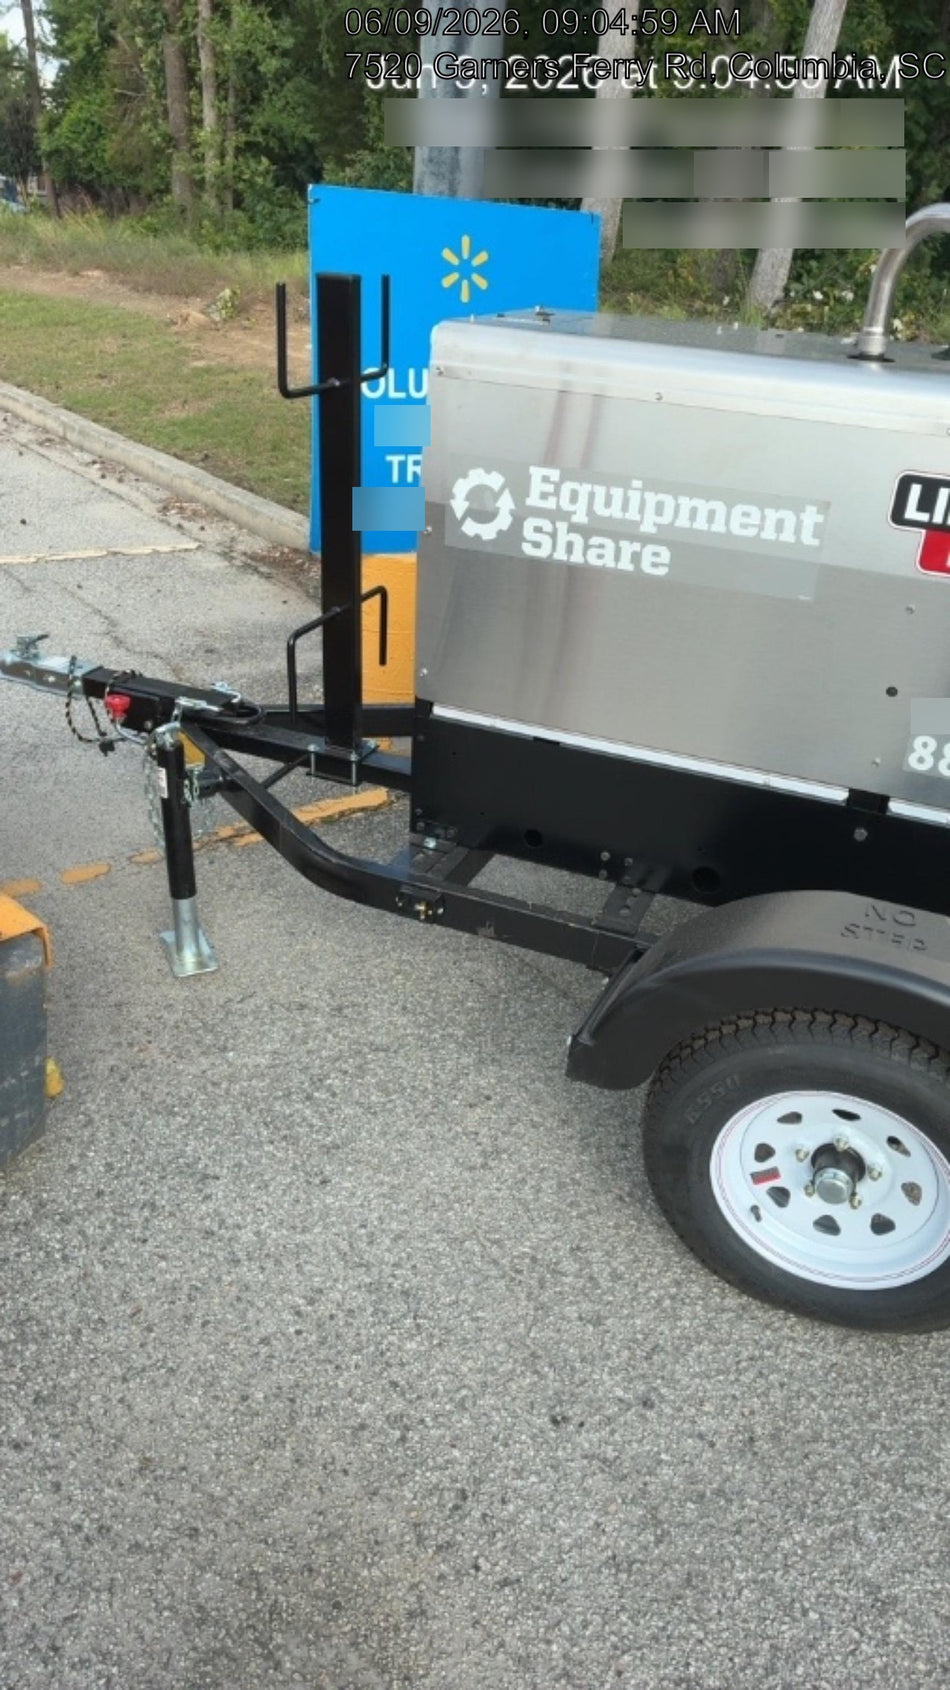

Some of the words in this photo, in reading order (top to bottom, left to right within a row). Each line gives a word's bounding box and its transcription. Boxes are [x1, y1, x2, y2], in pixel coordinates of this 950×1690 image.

[525, 466, 824, 546] Equipment
[904, 483, 950, 526] LI
[521, 517, 671, 576] Share
